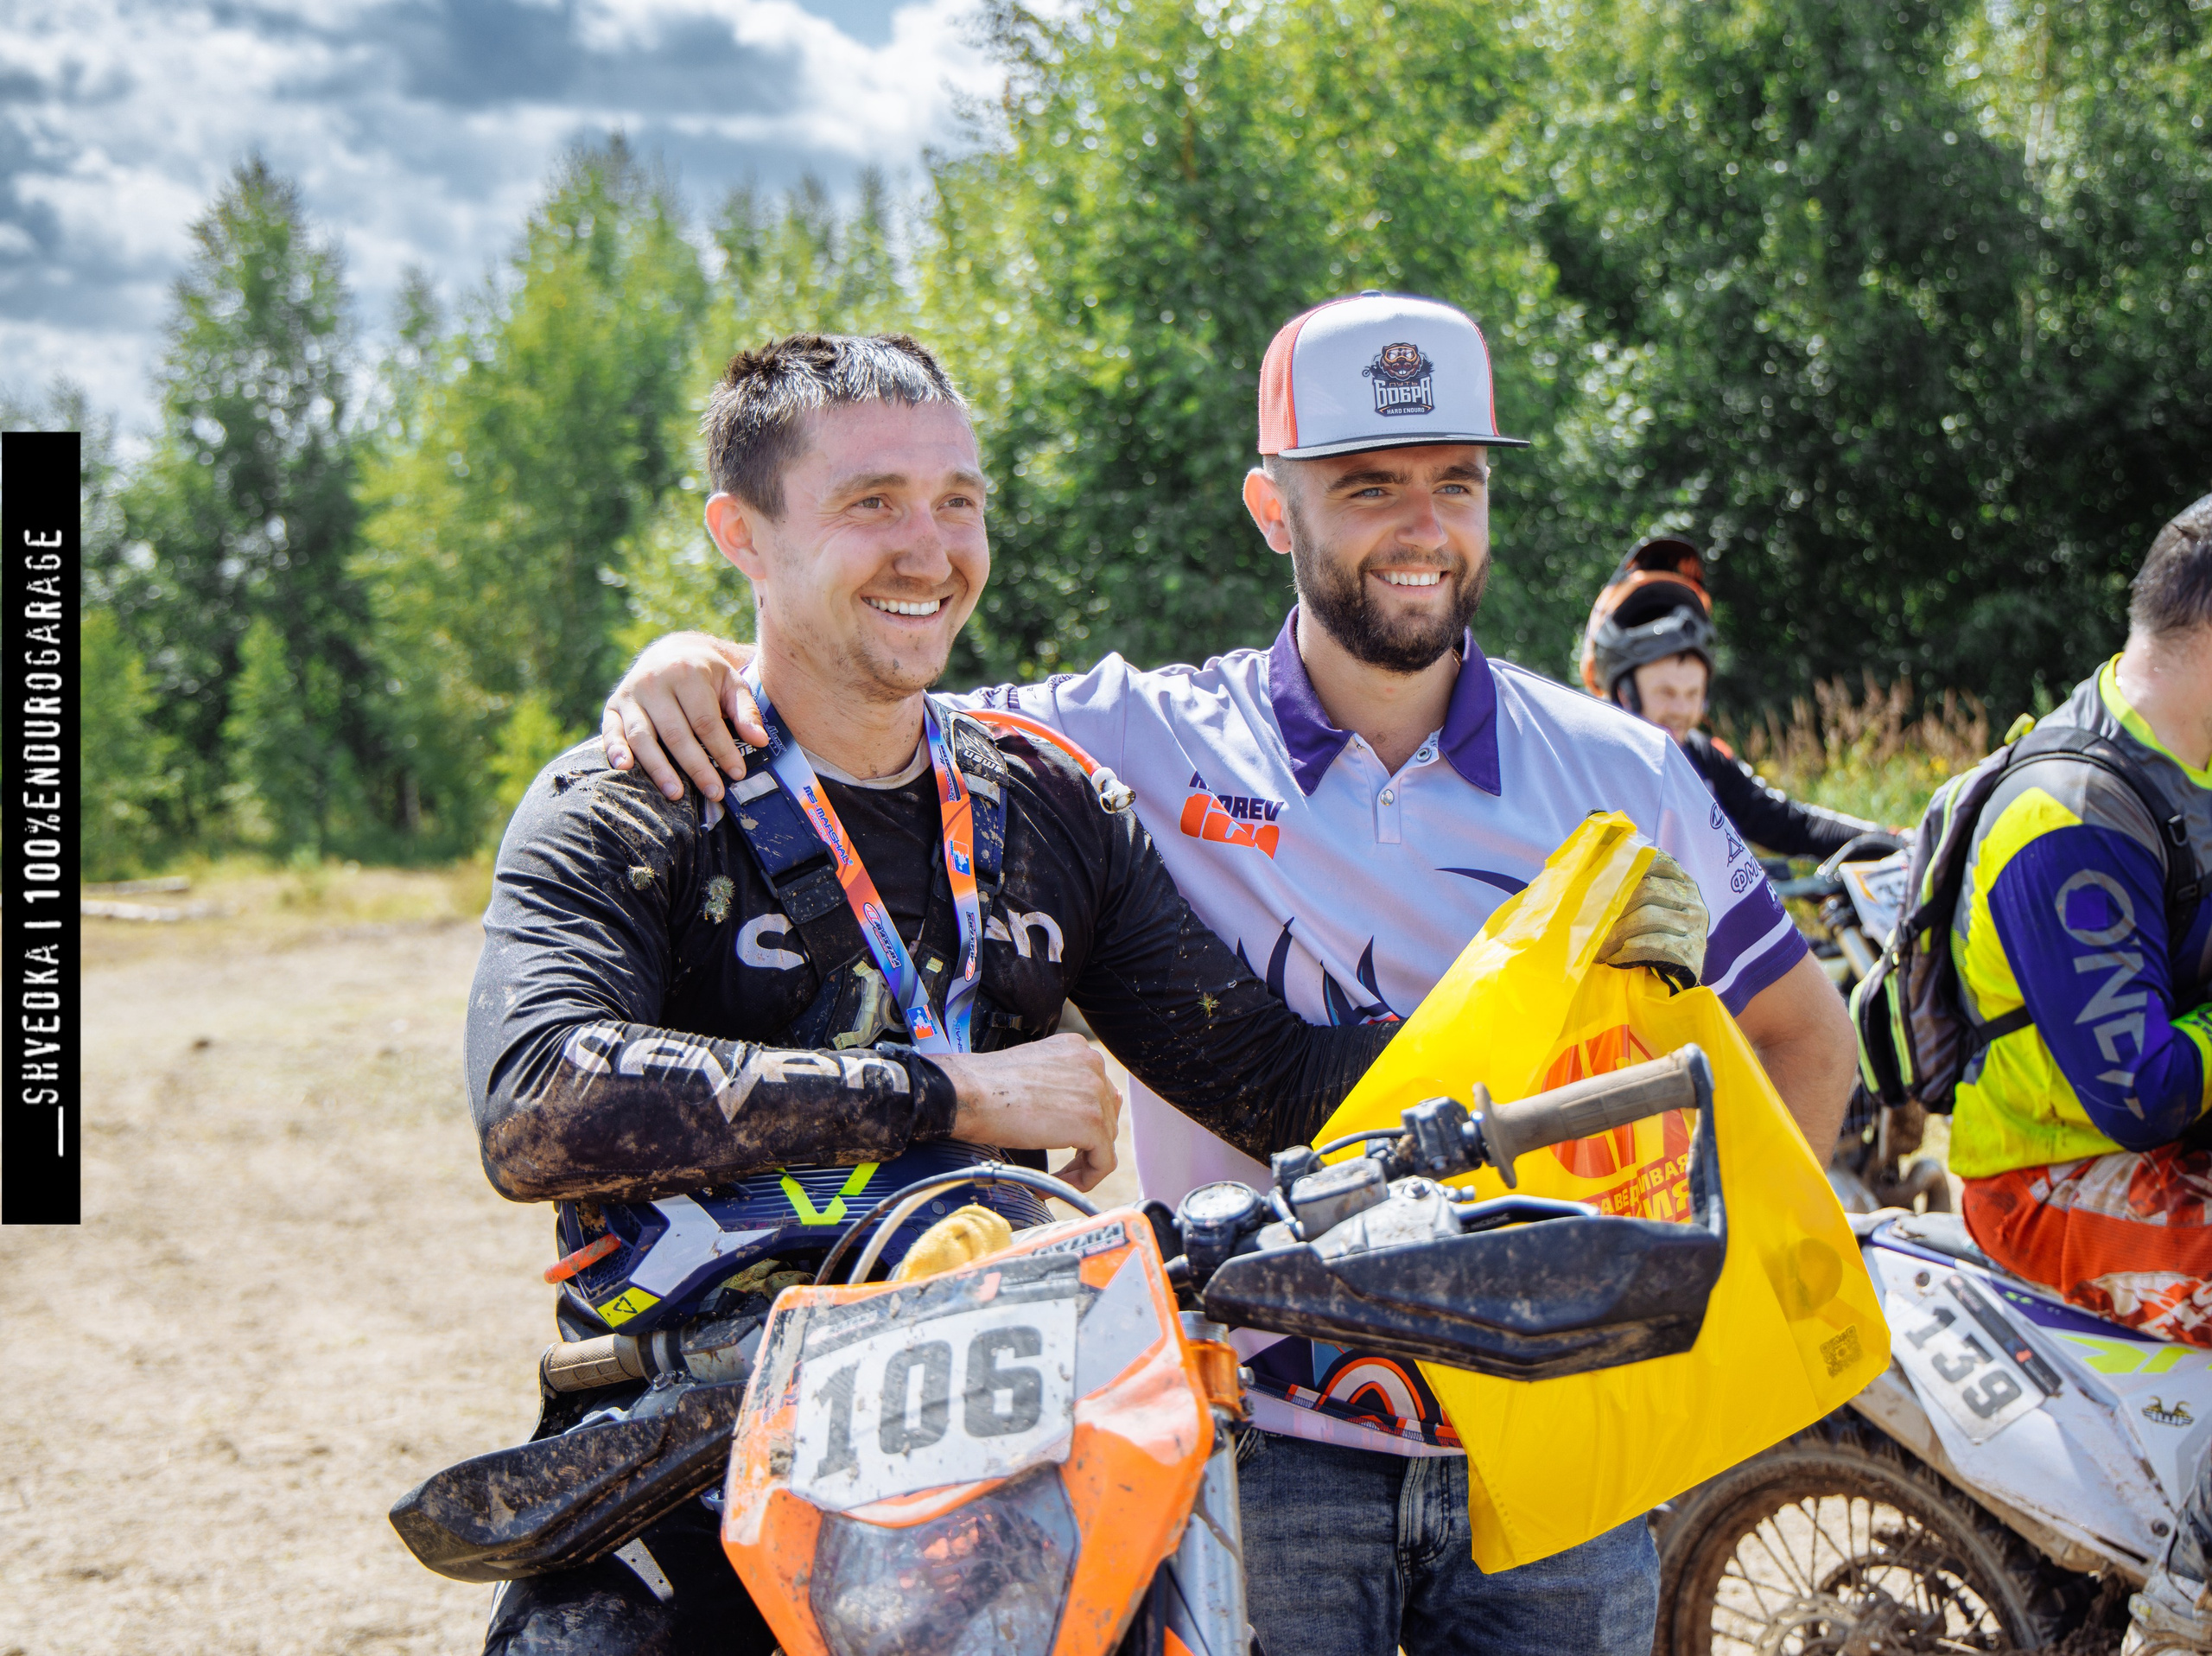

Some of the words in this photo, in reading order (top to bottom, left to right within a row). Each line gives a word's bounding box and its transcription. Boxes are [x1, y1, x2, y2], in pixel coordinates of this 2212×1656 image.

[1374, 376, 1433, 410] БОБРА
[1731, 857, 1764, 894] ФМ
[1905, 1306, 2024, 1420] 139
[815, 1325, 1043, 1479] 106
